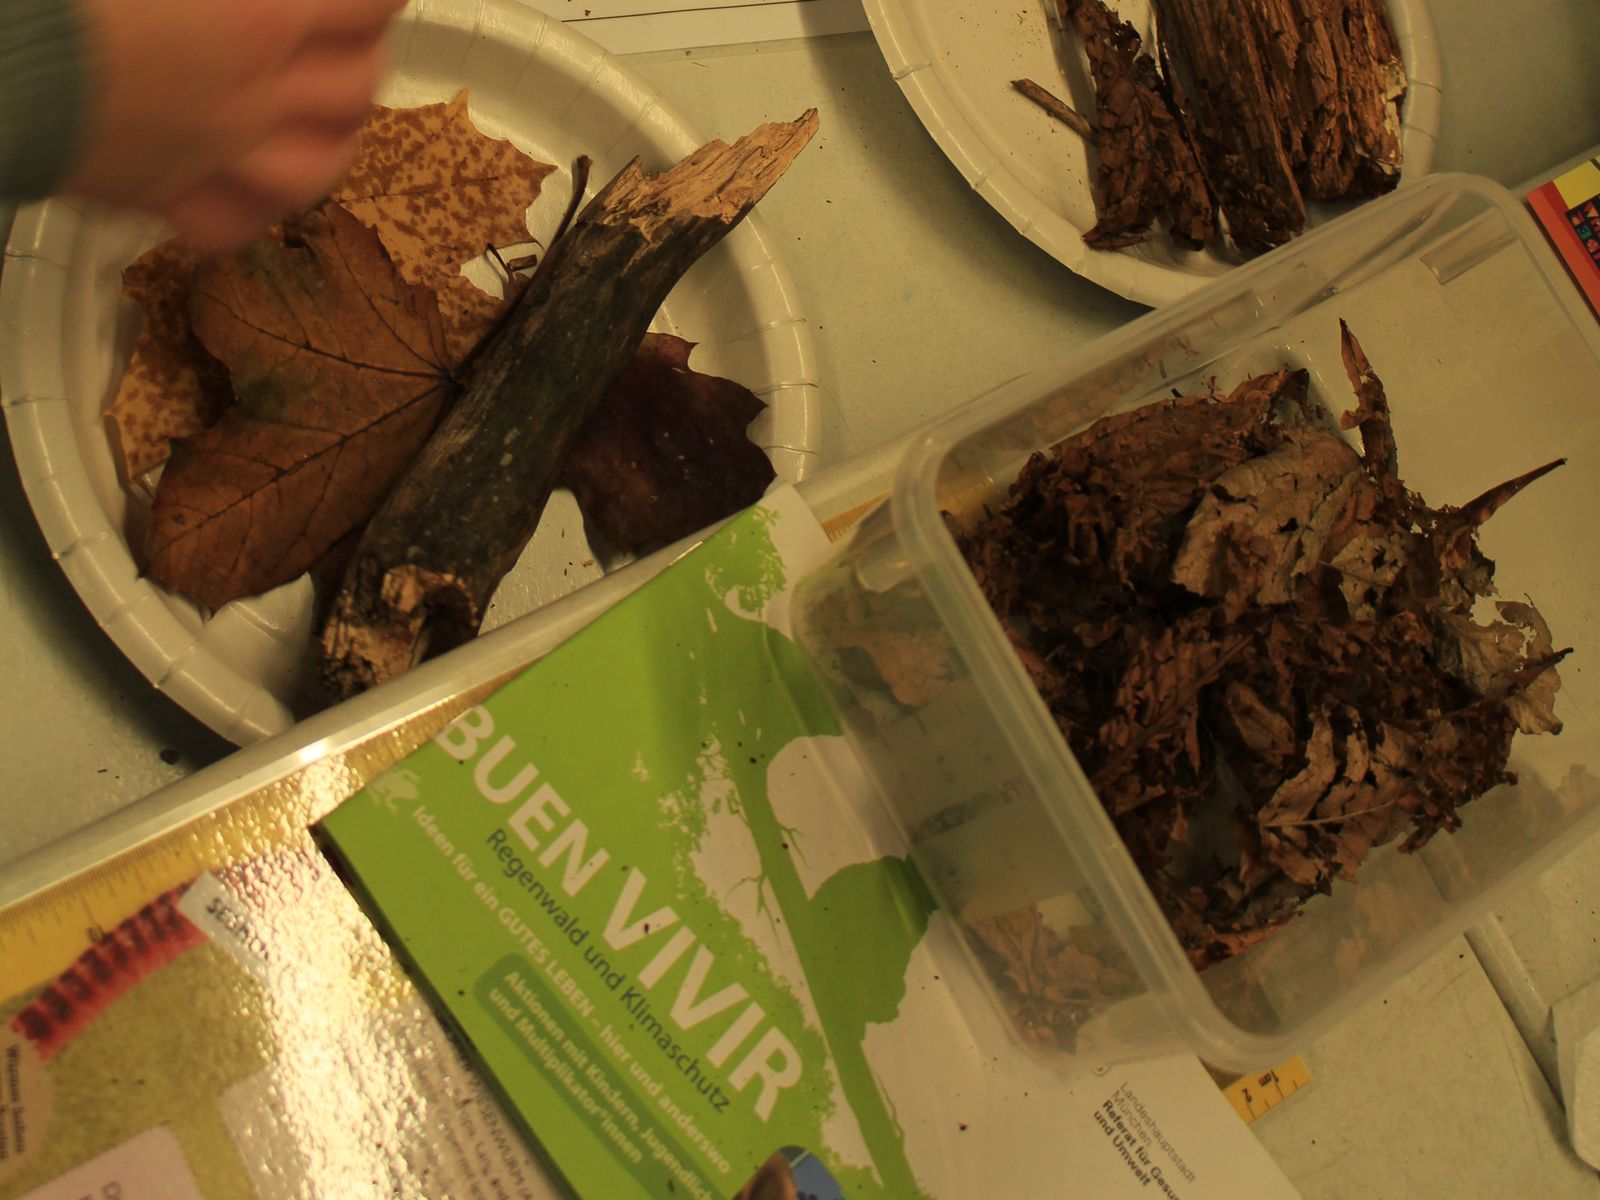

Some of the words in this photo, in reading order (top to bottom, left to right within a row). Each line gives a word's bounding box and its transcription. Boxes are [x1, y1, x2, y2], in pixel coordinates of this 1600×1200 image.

[432, 703, 609, 897] BUEN
[602, 867, 804, 1122] VIVIR
[413, 806, 454, 855] Ideen
[452, 853, 477, 881] für
[475, 883, 498, 908] ein
[499, 906, 549, 964] GUTES
[546, 961, 594, 1017] LEBEN
[600, 1025, 630, 1061] hier
[630, 1062, 663, 1096] und
[658, 1097, 730, 1174] anderswo
[487, 828, 589, 945] Regenwald
[585, 947, 625, 989] und
[622, 987, 728, 1112] Klimaschutz
[490, 989, 520, 1020] und
[505, 973, 564, 1040] Aktionen
[563, 1041, 589, 1067] mit
[1093, 1110, 1114, 1136] und
[1112, 1135, 1151, 1186] Umwelt
[1102, 1100, 1136, 1146] Referat
[1135, 1146, 1151, 1166] für
[1111, 1090, 1152, 1147] München
[1120, 1081, 1195, 1183] Landeshauptstadt
